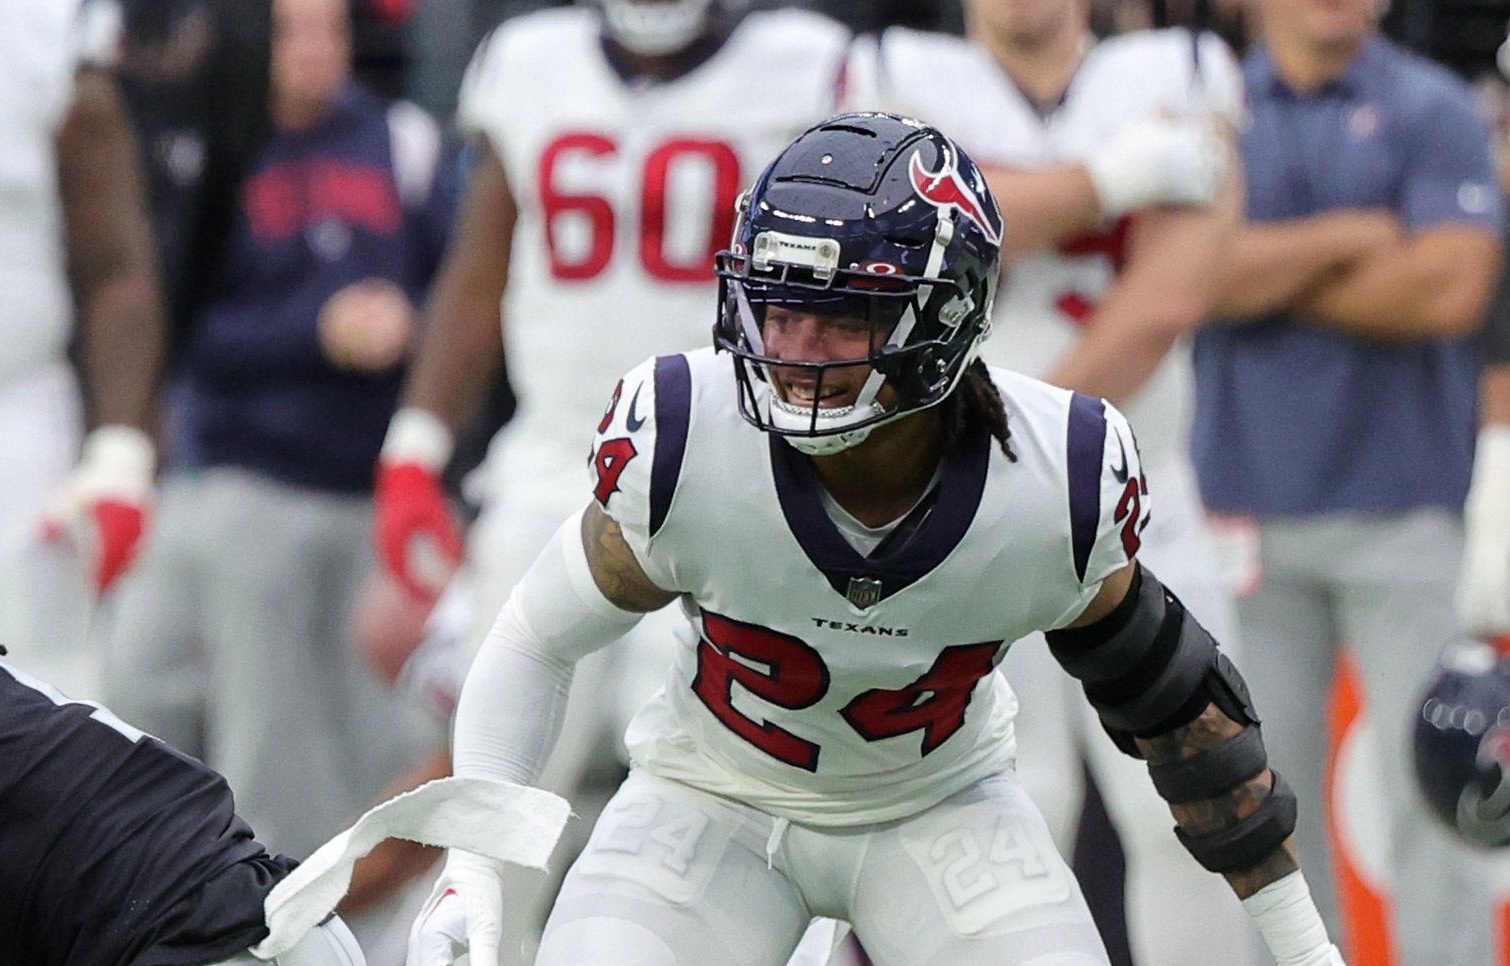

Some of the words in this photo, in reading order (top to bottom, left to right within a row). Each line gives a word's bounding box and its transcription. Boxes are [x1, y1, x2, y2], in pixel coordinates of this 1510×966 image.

[540, 133, 741, 284] 60
[810, 616, 910, 637] TEXANS
[690, 604, 1006, 775] 24
[592, 794, 712, 878] 24
[929, 813, 1050, 912] 24
